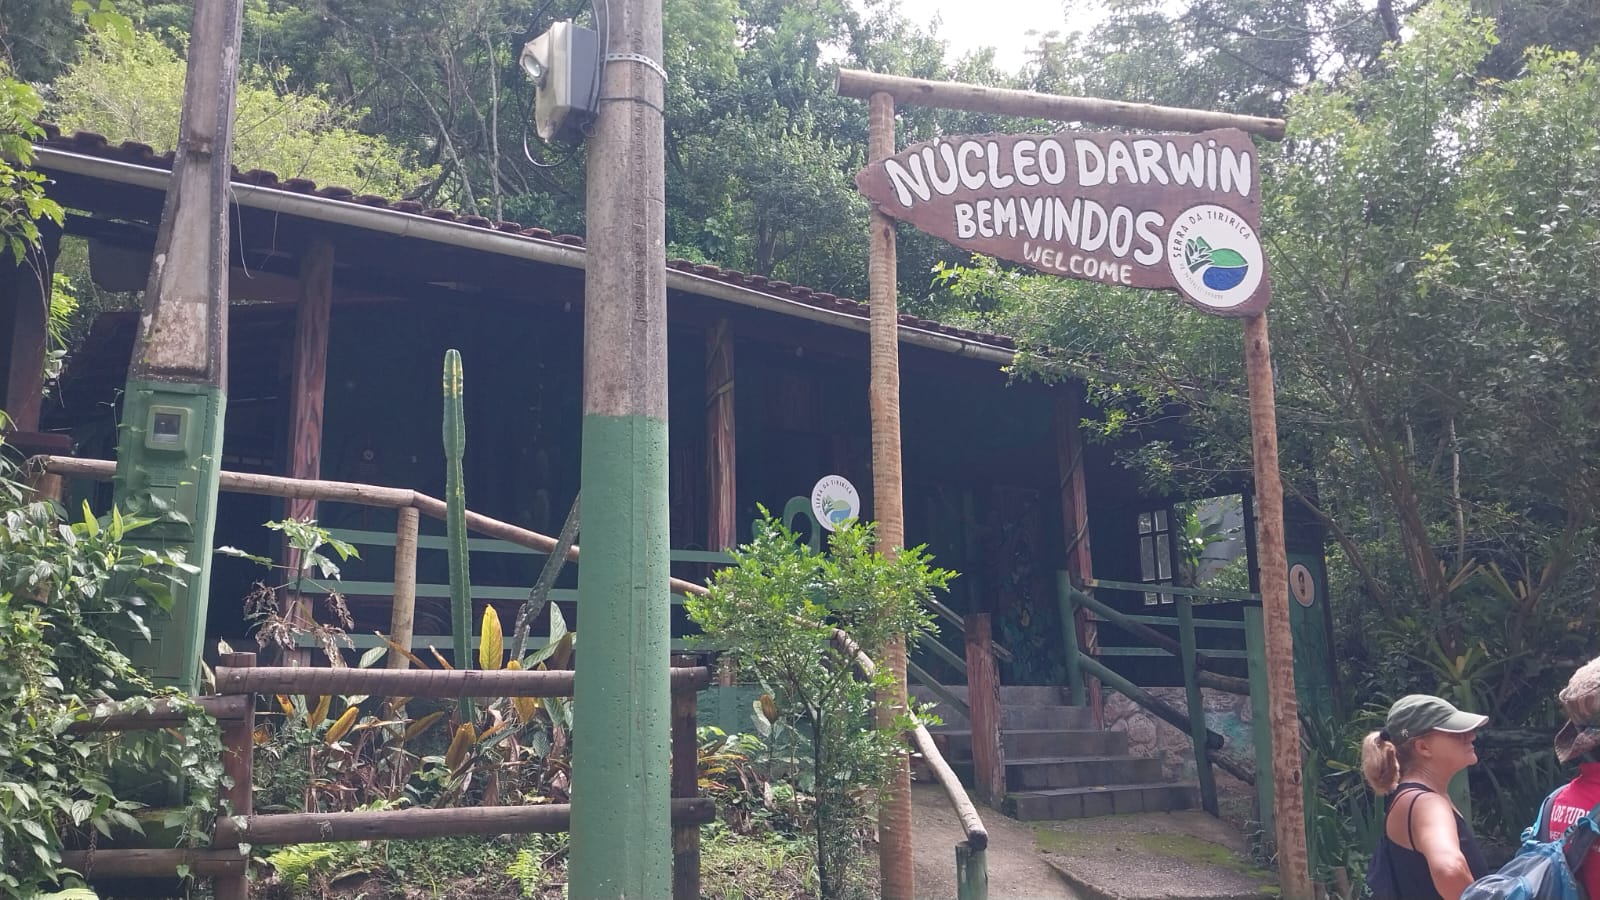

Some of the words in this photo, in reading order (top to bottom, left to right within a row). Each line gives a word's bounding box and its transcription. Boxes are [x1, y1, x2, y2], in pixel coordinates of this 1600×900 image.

[884, 136, 1066, 208] NÚCLEO
[1172, 225, 1189, 258] SERRA
[1188, 213, 1203, 224] DA
[1208, 210, 1250, 240] TIRIRICA
[1023, 241, 1132, 284] WELCOME
